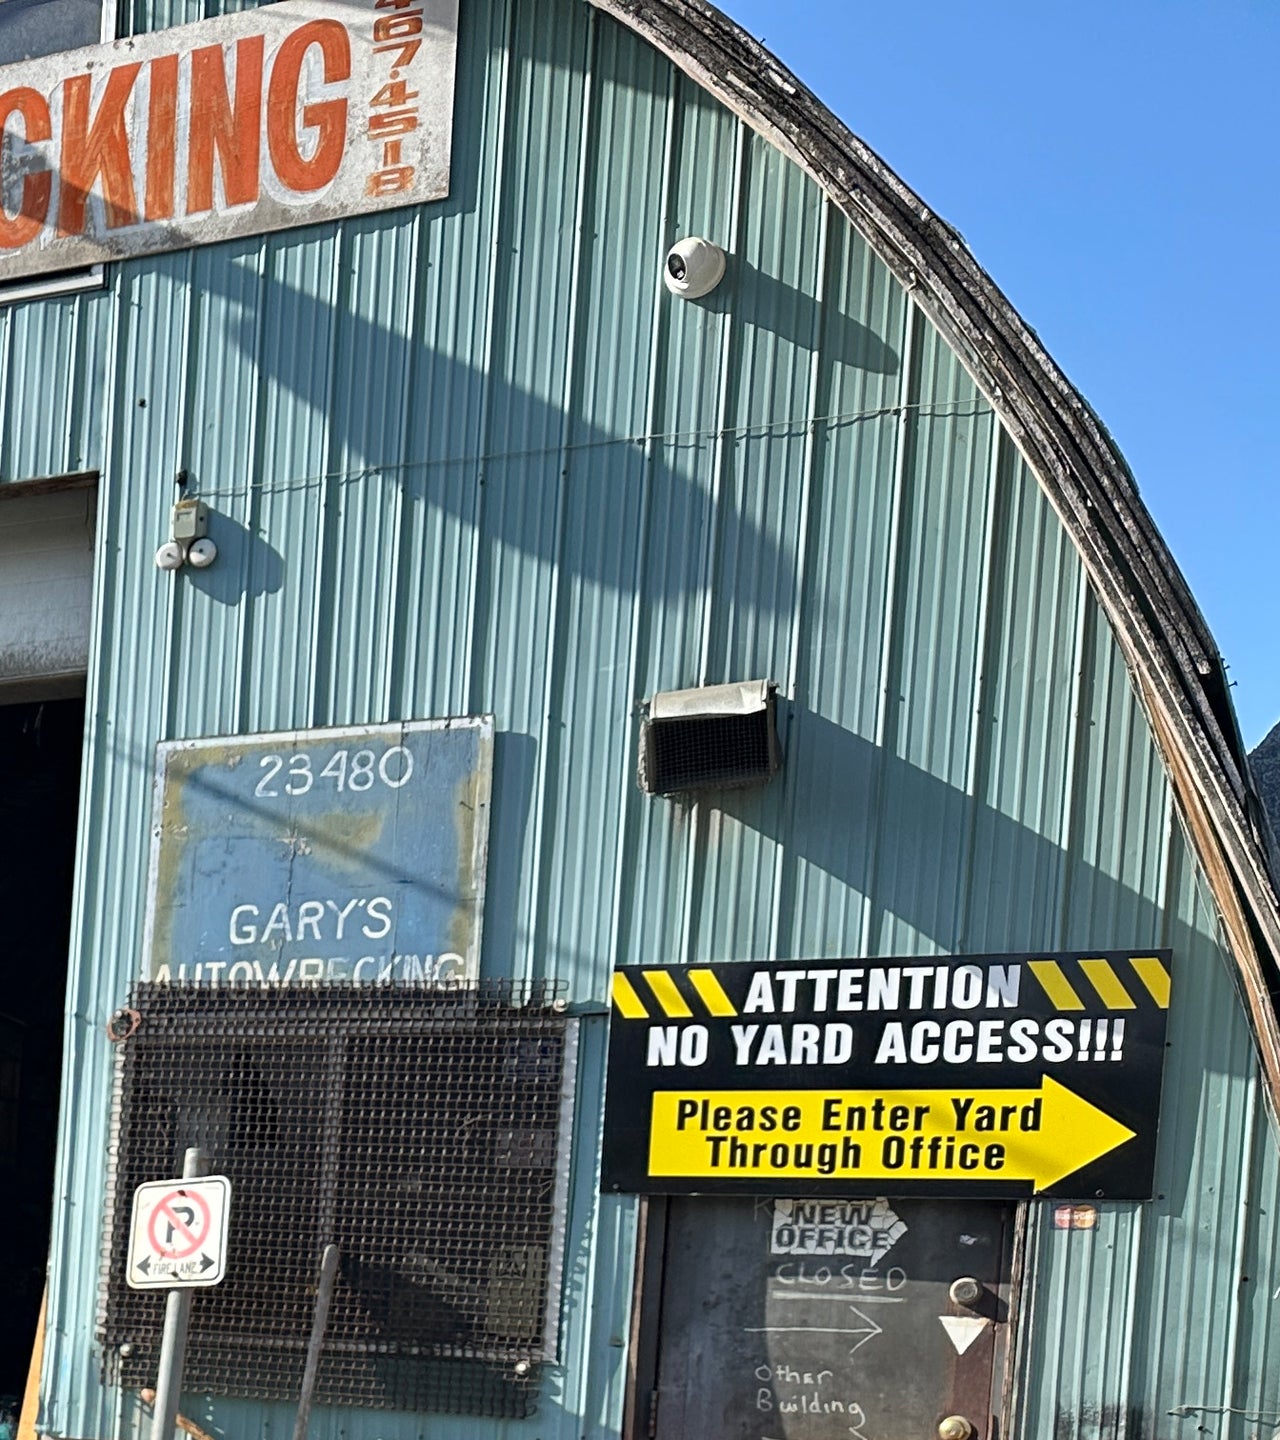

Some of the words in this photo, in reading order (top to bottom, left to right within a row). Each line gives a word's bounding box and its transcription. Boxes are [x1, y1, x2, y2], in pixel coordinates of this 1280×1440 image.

[254, 745, 415, 798] 23480
[228, 896, 393, 945] GARY'S
[742, 963, 1022, 1014] ATTENTION
[645, 1024, 709, 1067] NO
[730, 1022, 853, 1067] YARD
[874, 1018, 1126, 1065] ACCESS!!!
[676, 1098, 801, 1132] Please
[822, 1097, 930, 1132] Enter
[950, 1097, 1043, 1132] Yard
[705, 1135, 861, 1175] Through
[882, 1135, 1006, 1171] Office
[794, 1204, 873, 1225] NEW
[775, 1225, 890, 1249] OFFICE
[756, 1387, 865, 1430] Building
